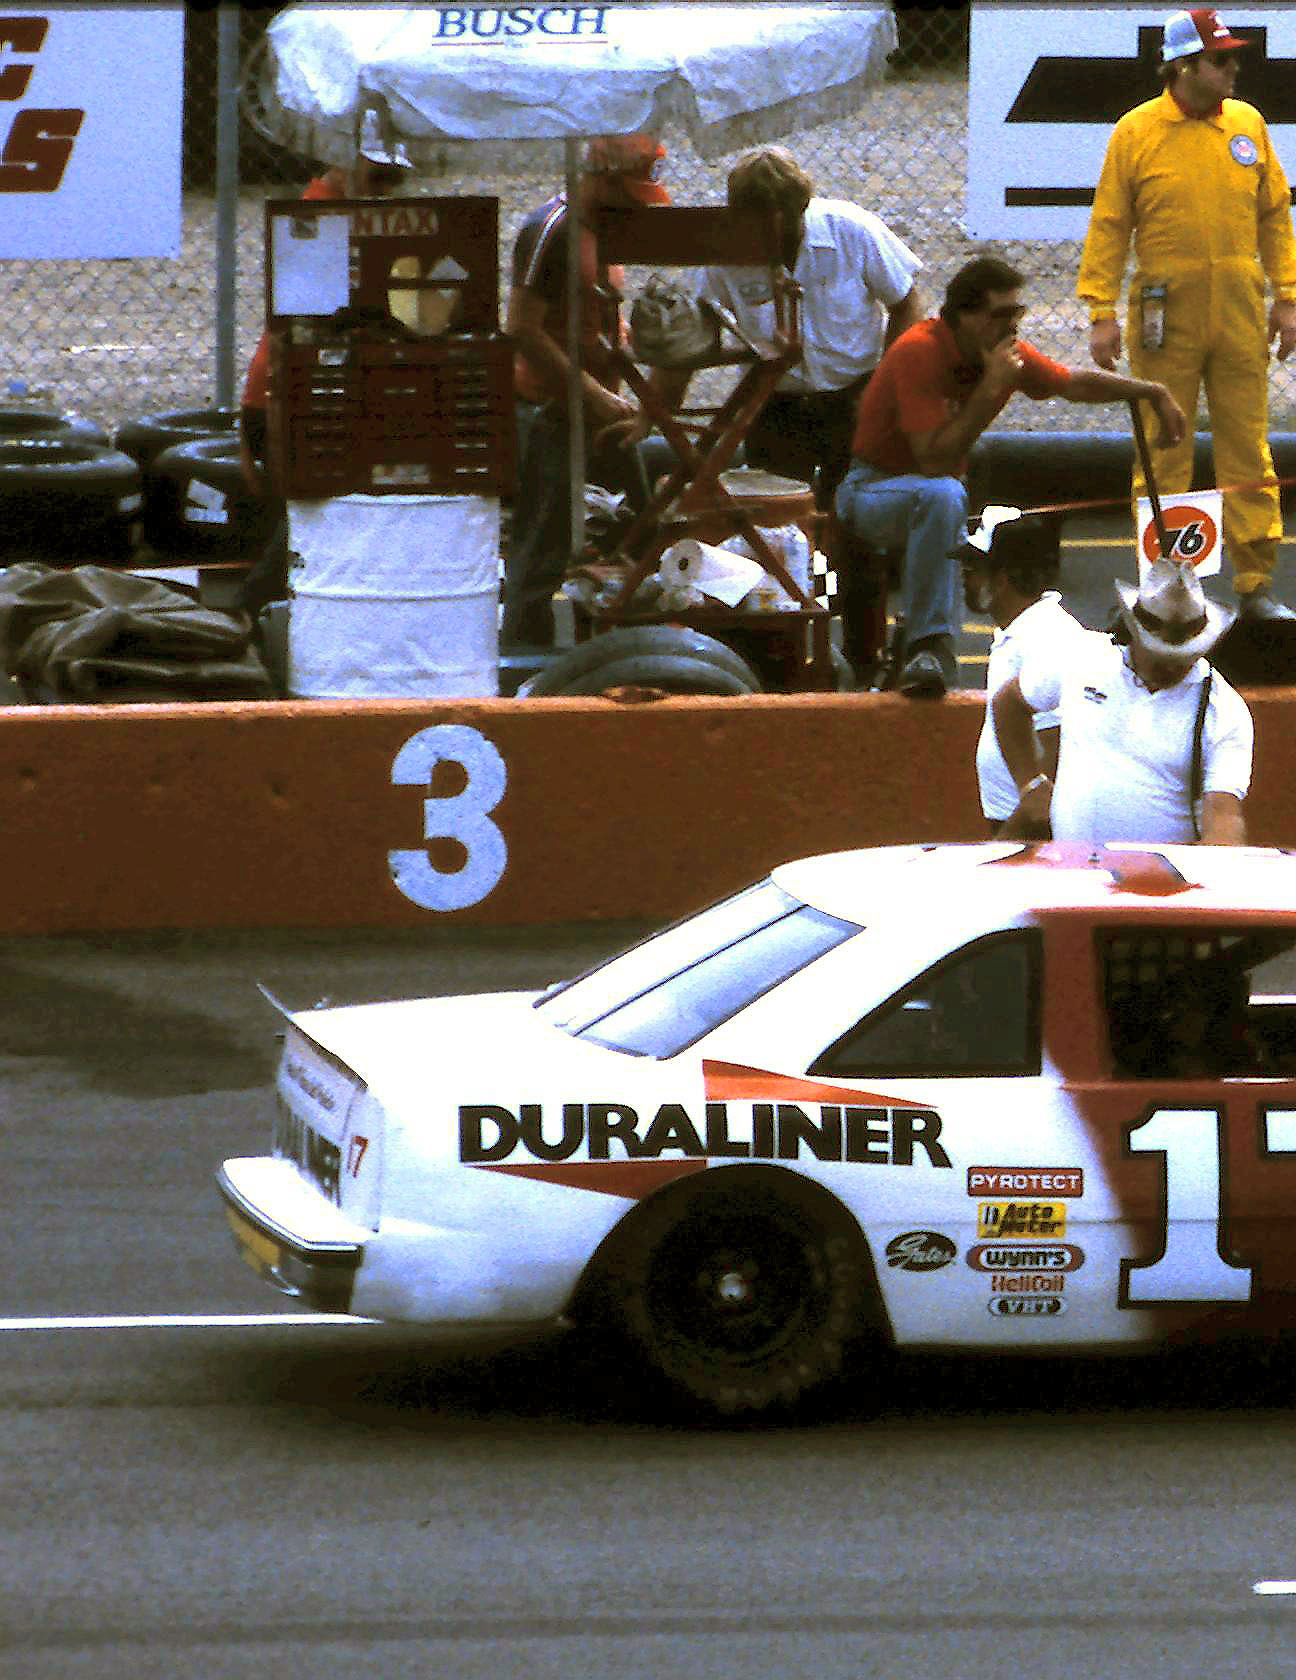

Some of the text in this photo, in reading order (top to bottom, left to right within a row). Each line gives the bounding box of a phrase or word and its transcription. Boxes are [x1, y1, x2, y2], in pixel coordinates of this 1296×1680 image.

[432, 7, 611, 38] BUSCH
[387, 724, 508, 912] 3
[458, 1103, 953, 1168] DURALINER
[970, 1174, 1081, 1190] PYROTECT
[1005, 1203, 1053, 1219] Auto
